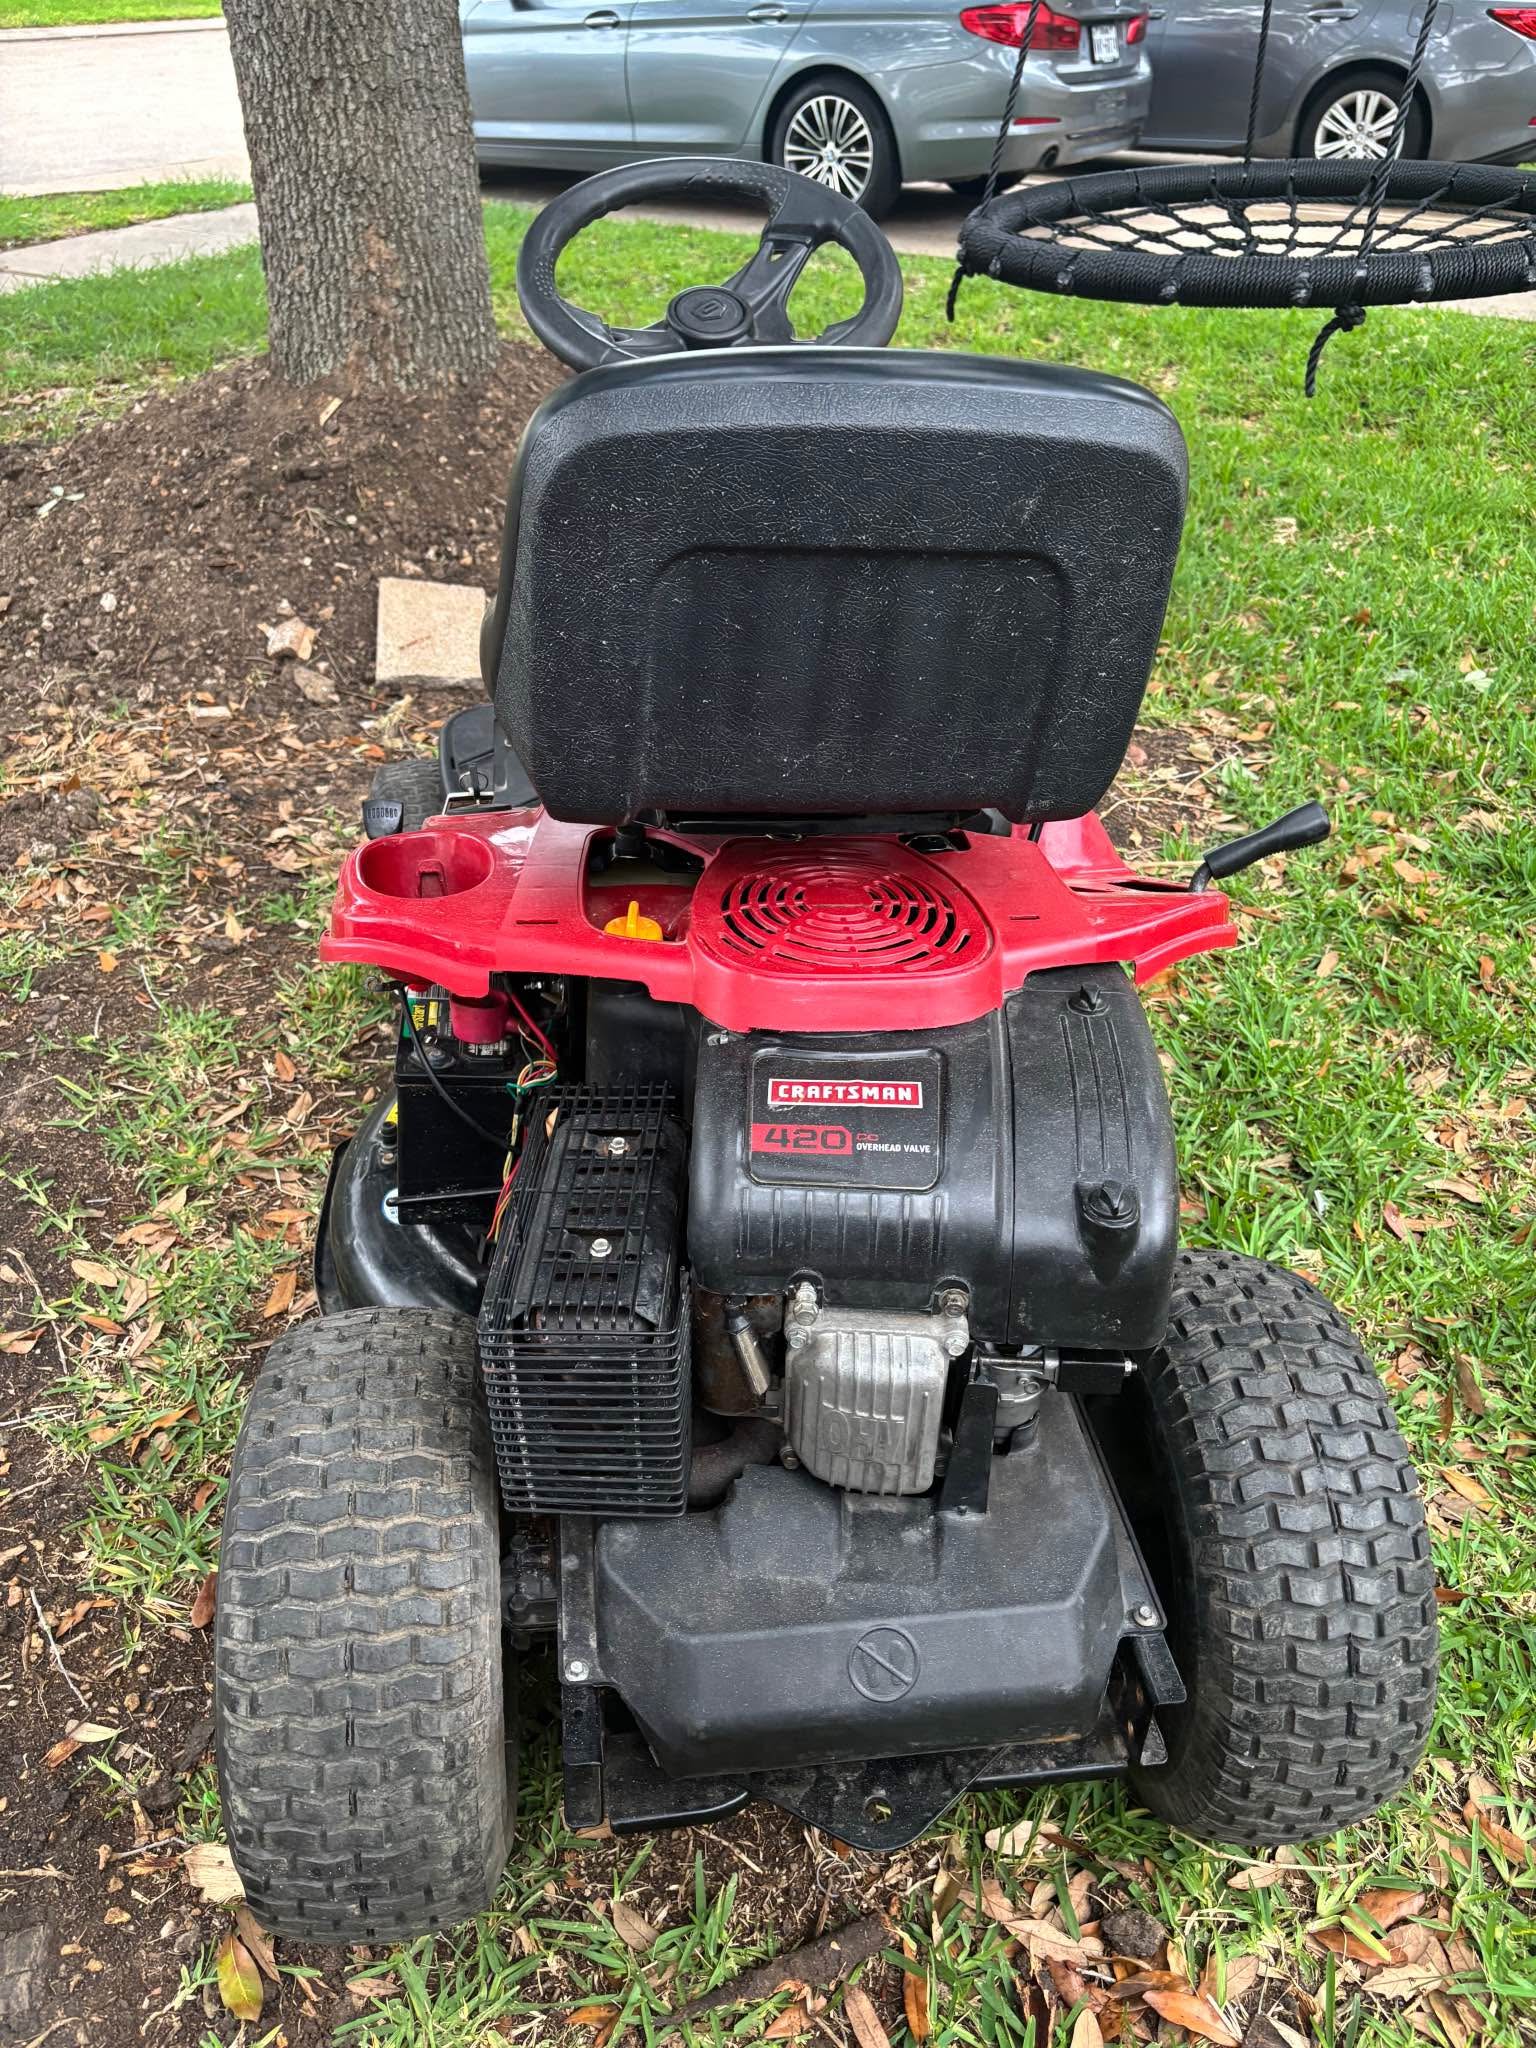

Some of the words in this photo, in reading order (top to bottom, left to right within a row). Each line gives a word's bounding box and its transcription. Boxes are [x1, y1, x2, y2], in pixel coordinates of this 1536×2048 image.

[777, 1084, 913, 1101] CRAFTSMAN
[764, 1127, 848, 1150] 420
[856, 1142, 901, 1152] OVERHEAD
[903, 1144, 931, 1153] VALVE
[822, 1409, 909, 1463] OHV
